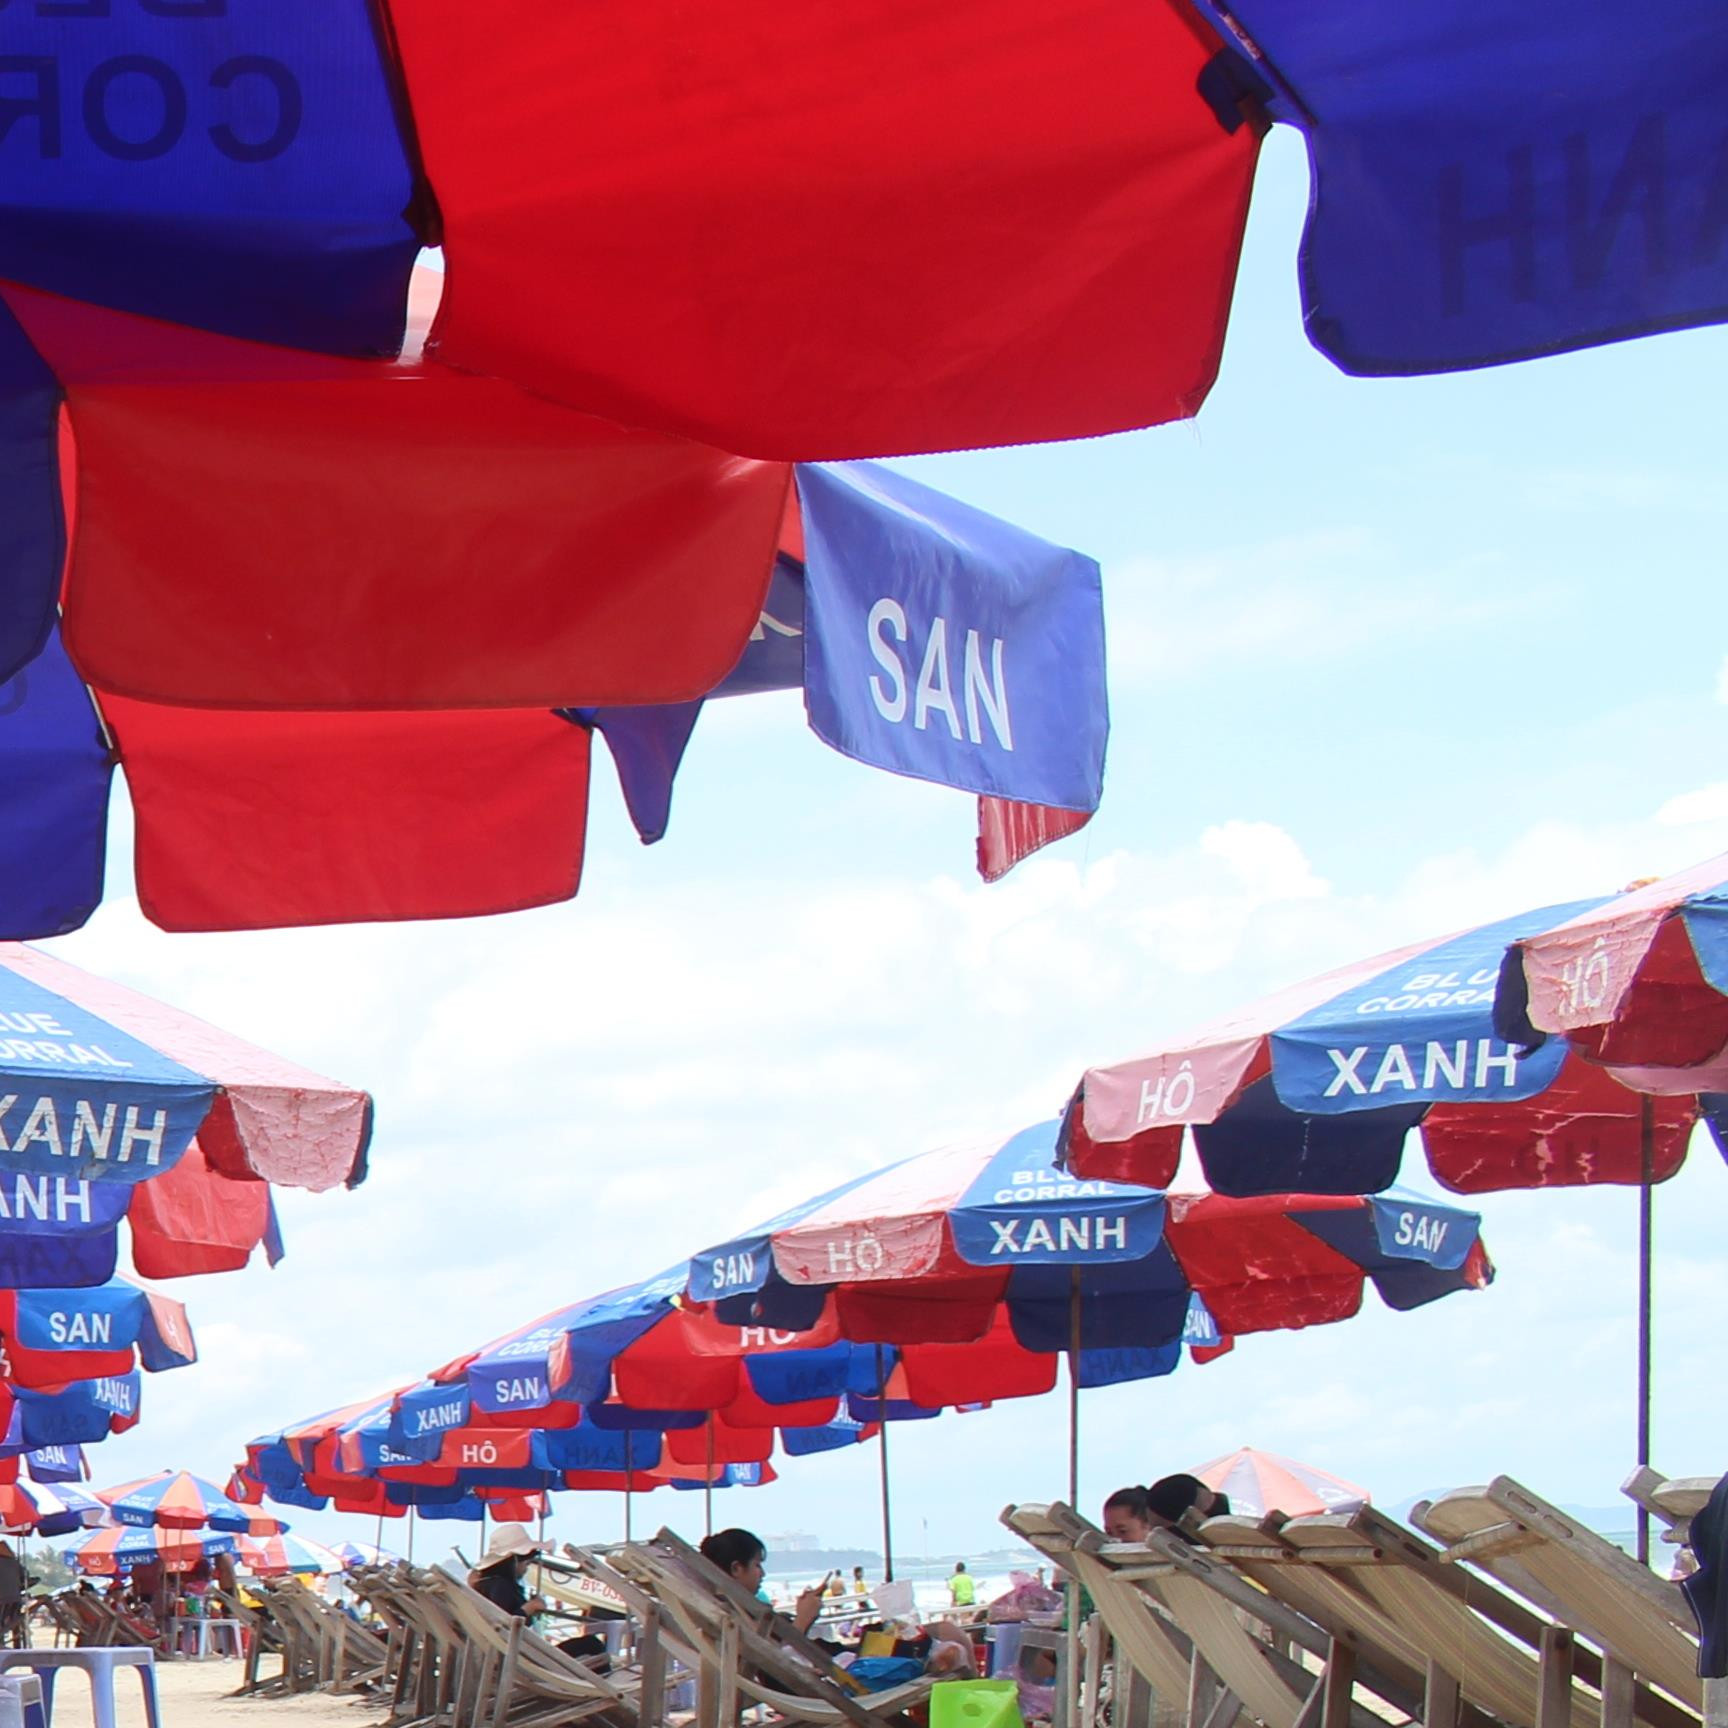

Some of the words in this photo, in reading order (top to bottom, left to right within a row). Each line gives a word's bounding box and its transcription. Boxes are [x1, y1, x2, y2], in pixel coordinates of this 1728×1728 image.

[867, 598, 1014, 752] SAN
[1558, 938, 1609, 1014] HÔ
[1323, 1037, 1520, 1098] XANH
[1137, 1060, 1197, 1124] HÔ
[993, 1182, 1115, 1206] CORRAL
[989, 1215, 1127, 1256] XANH
[1394, 1211, 1448, 1255] SAN
[712, 1253, 754, 1290] SAN
[828, 1232, 884, 1274] HÔ
[49, 1311, 112, 1344] SAN
[95, 1377, 131, 1412] XANH
[496, 1376, 539, 1403] SAN
[416, 1402, 463, 1432] XANH
[463, 1440, 498, 1464] HÔ
[122, 1512, 144, 1525] SAN
